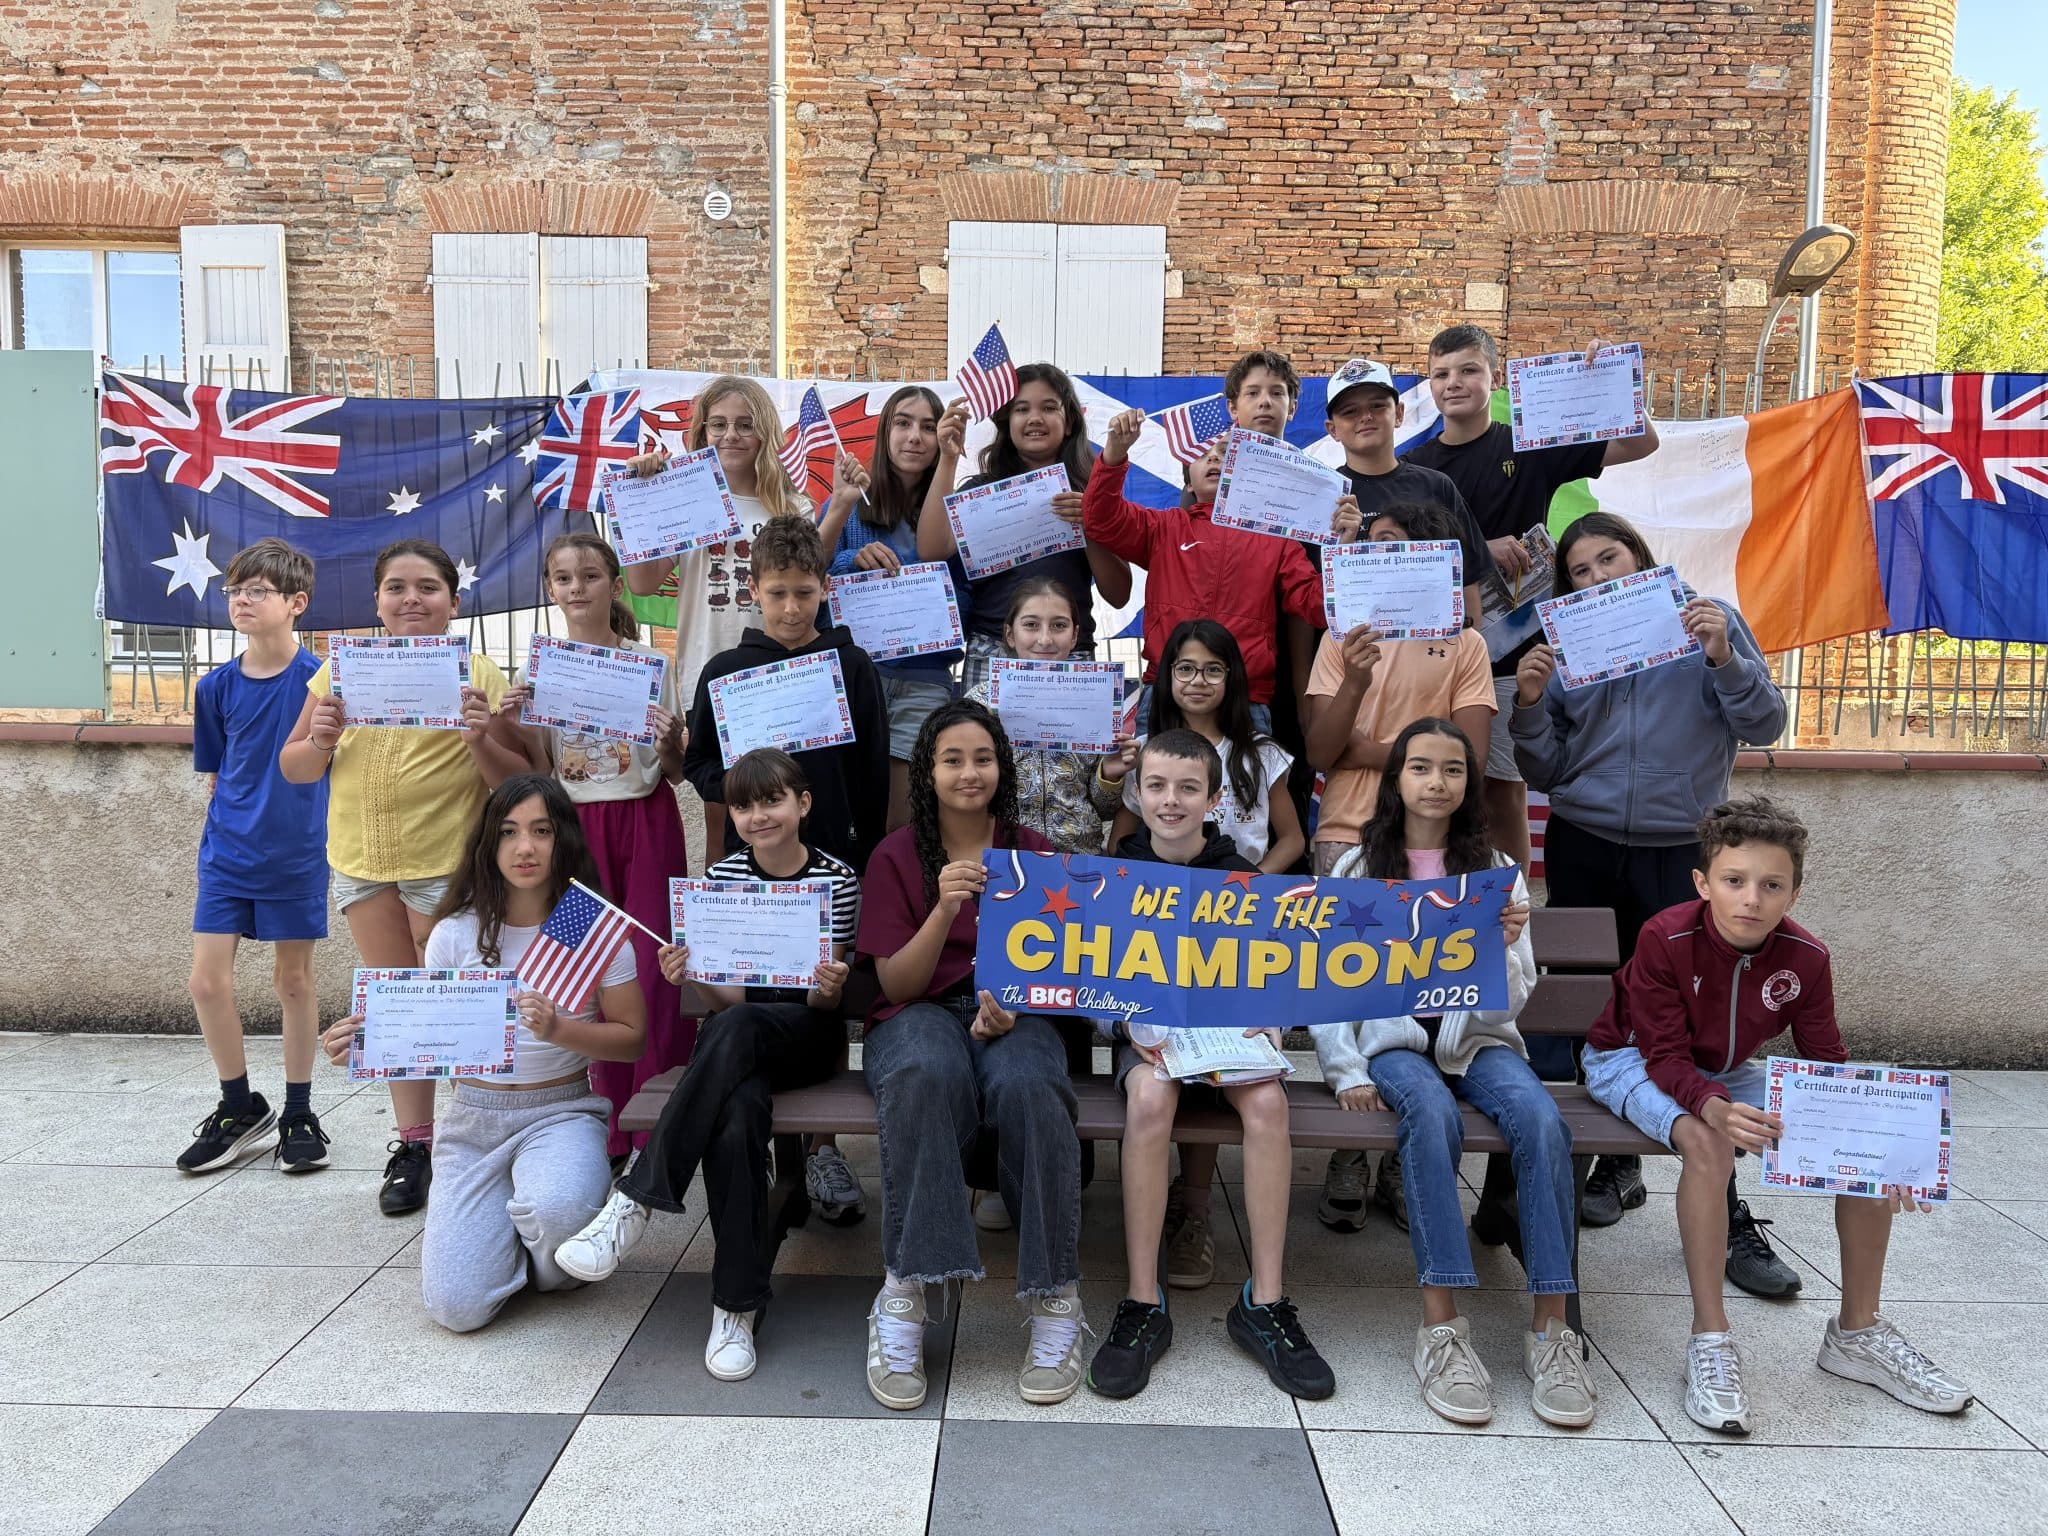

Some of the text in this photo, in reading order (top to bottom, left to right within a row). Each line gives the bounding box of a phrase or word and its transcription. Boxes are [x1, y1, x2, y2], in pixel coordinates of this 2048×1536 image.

[1527, 368, 1564, 379] Certificate
[1567, 365, 1574, 373] of
[1341, 555, 1445, 567] Certificate of Participation
[882, 582, 888, 590] of
[1600, 598, 1607, 607] of
[346, 650, 451, 660] Certificate of Participation
[587, 658, 594, 666] of
[1007, 673, 1107, 684] Certificate of Participation
[692, 895, 811, 907] Certificate of Participation
[1131, 885, 1339, 931] WE ARE THE
[1005, 919, 1477, 989] CHAMPIONS
[377, 985, 498, 995] Certificate of Participation
[1001, 984, 1153, 1020] the BIG Challenge
[1414, 984, 1480, 1011] 2026
[1794, 1079, 1932, 1101] Certificate of Participation
[1833, 1149, 1886, 1161] Congratulations!
[1839, 1166, 1857, 1175] BIG
